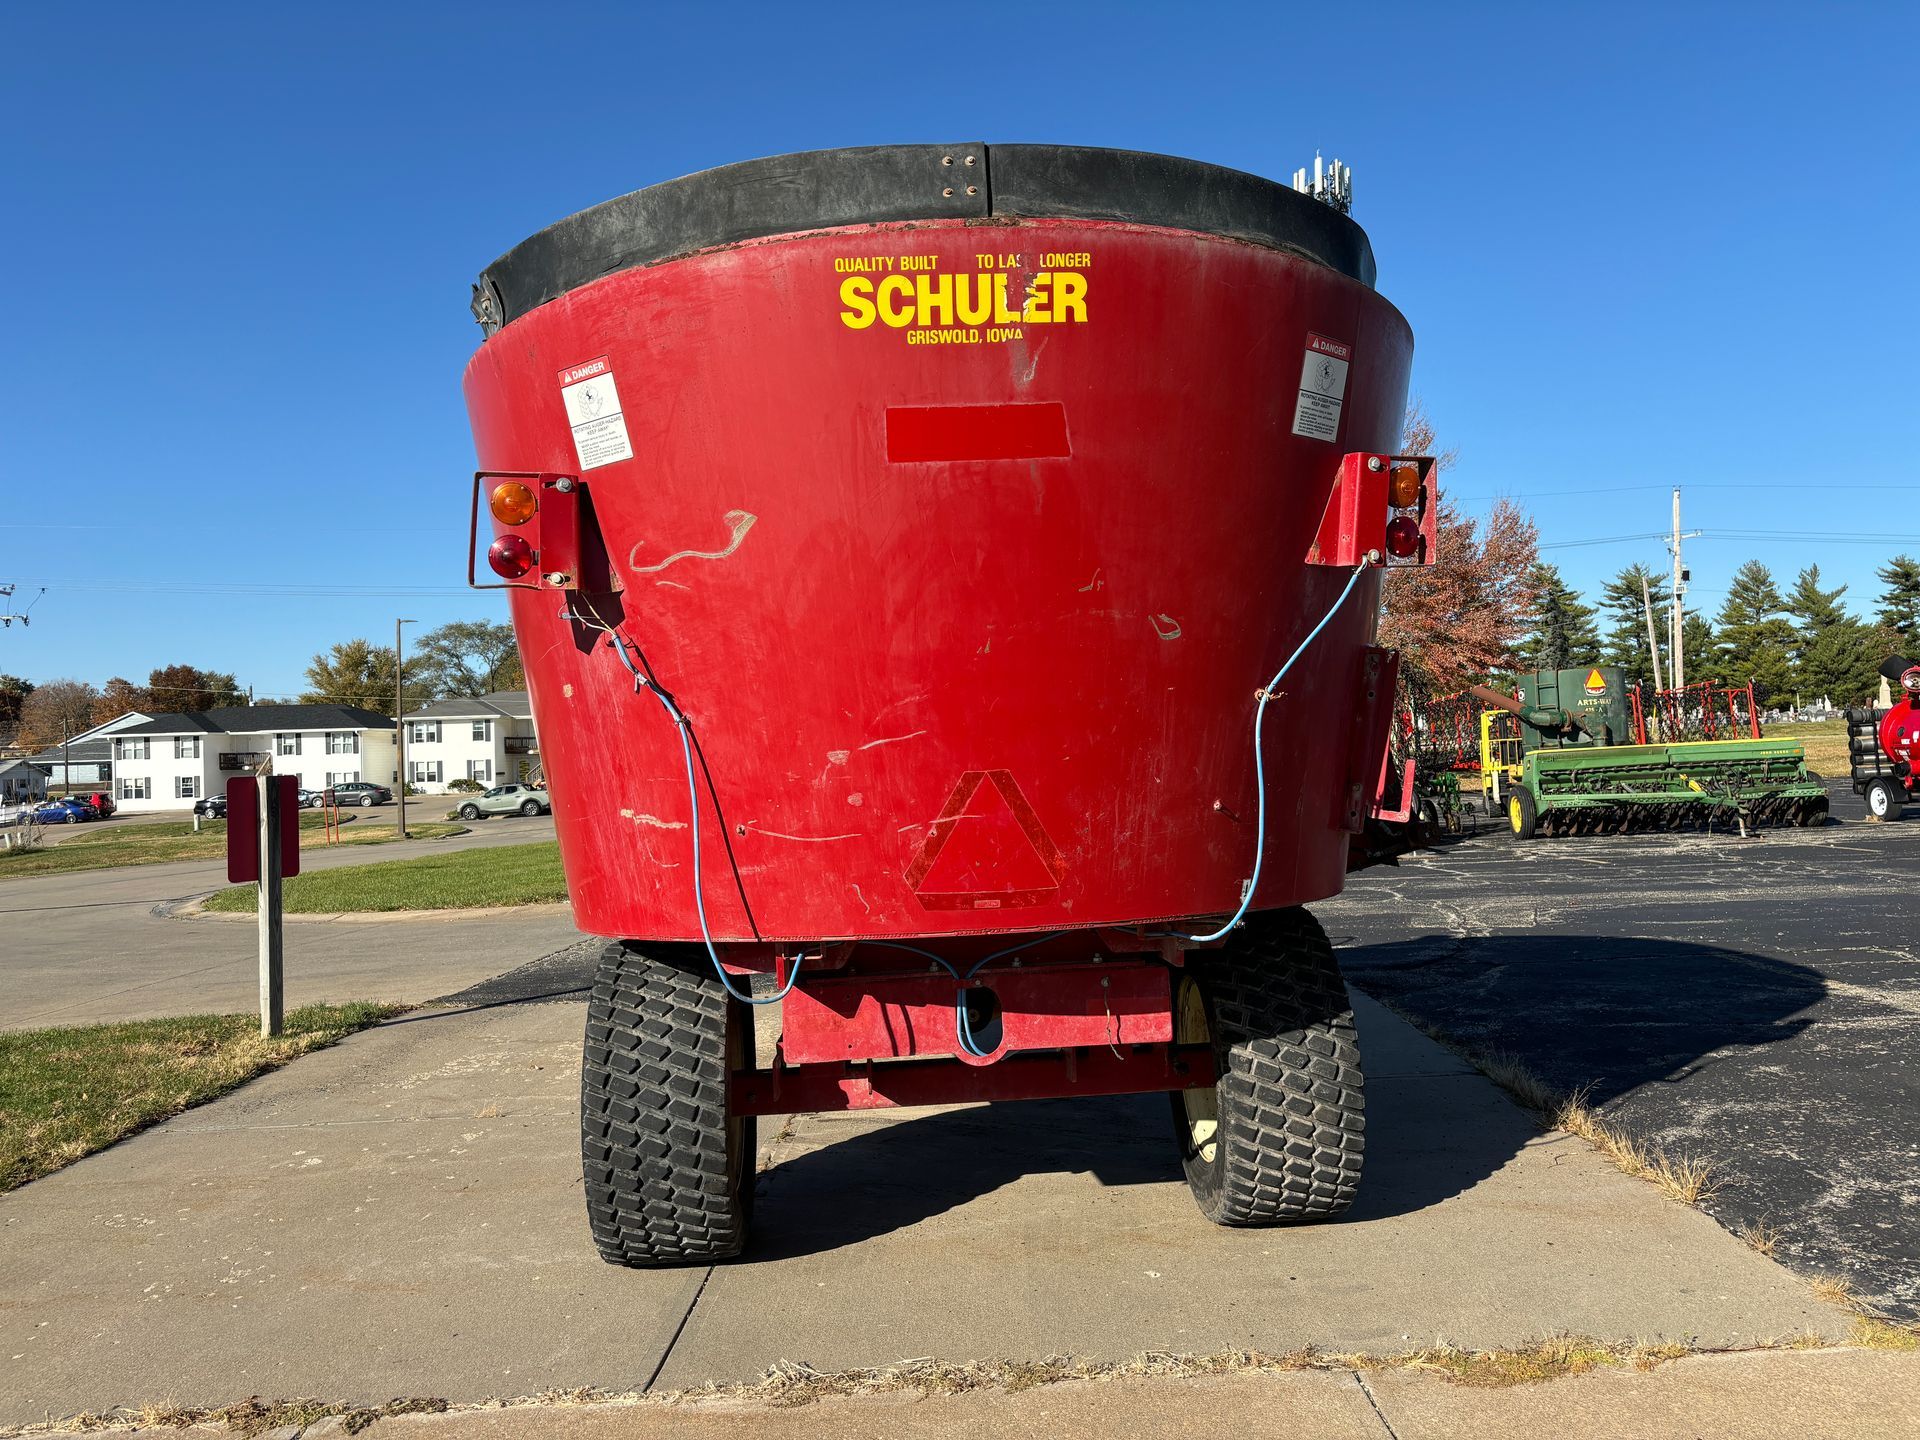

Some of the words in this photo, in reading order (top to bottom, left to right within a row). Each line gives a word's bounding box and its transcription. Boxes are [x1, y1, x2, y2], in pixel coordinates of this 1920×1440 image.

[834, 256, 895, 273] QUALITY
[900, 255, 938, 271] BUILT
[976, 254, 994, 269] TO
[1039, 252, 1091, 268] LONGER
[839, 272, 1089, 330] SCHULER
[906, 328, 983, 345] GRISWOLD,
[986, 327, 1023, 343] IOWA
[1320, 341, 1347, 357] DANGER
[571, 361, 605, 380] DANGER
